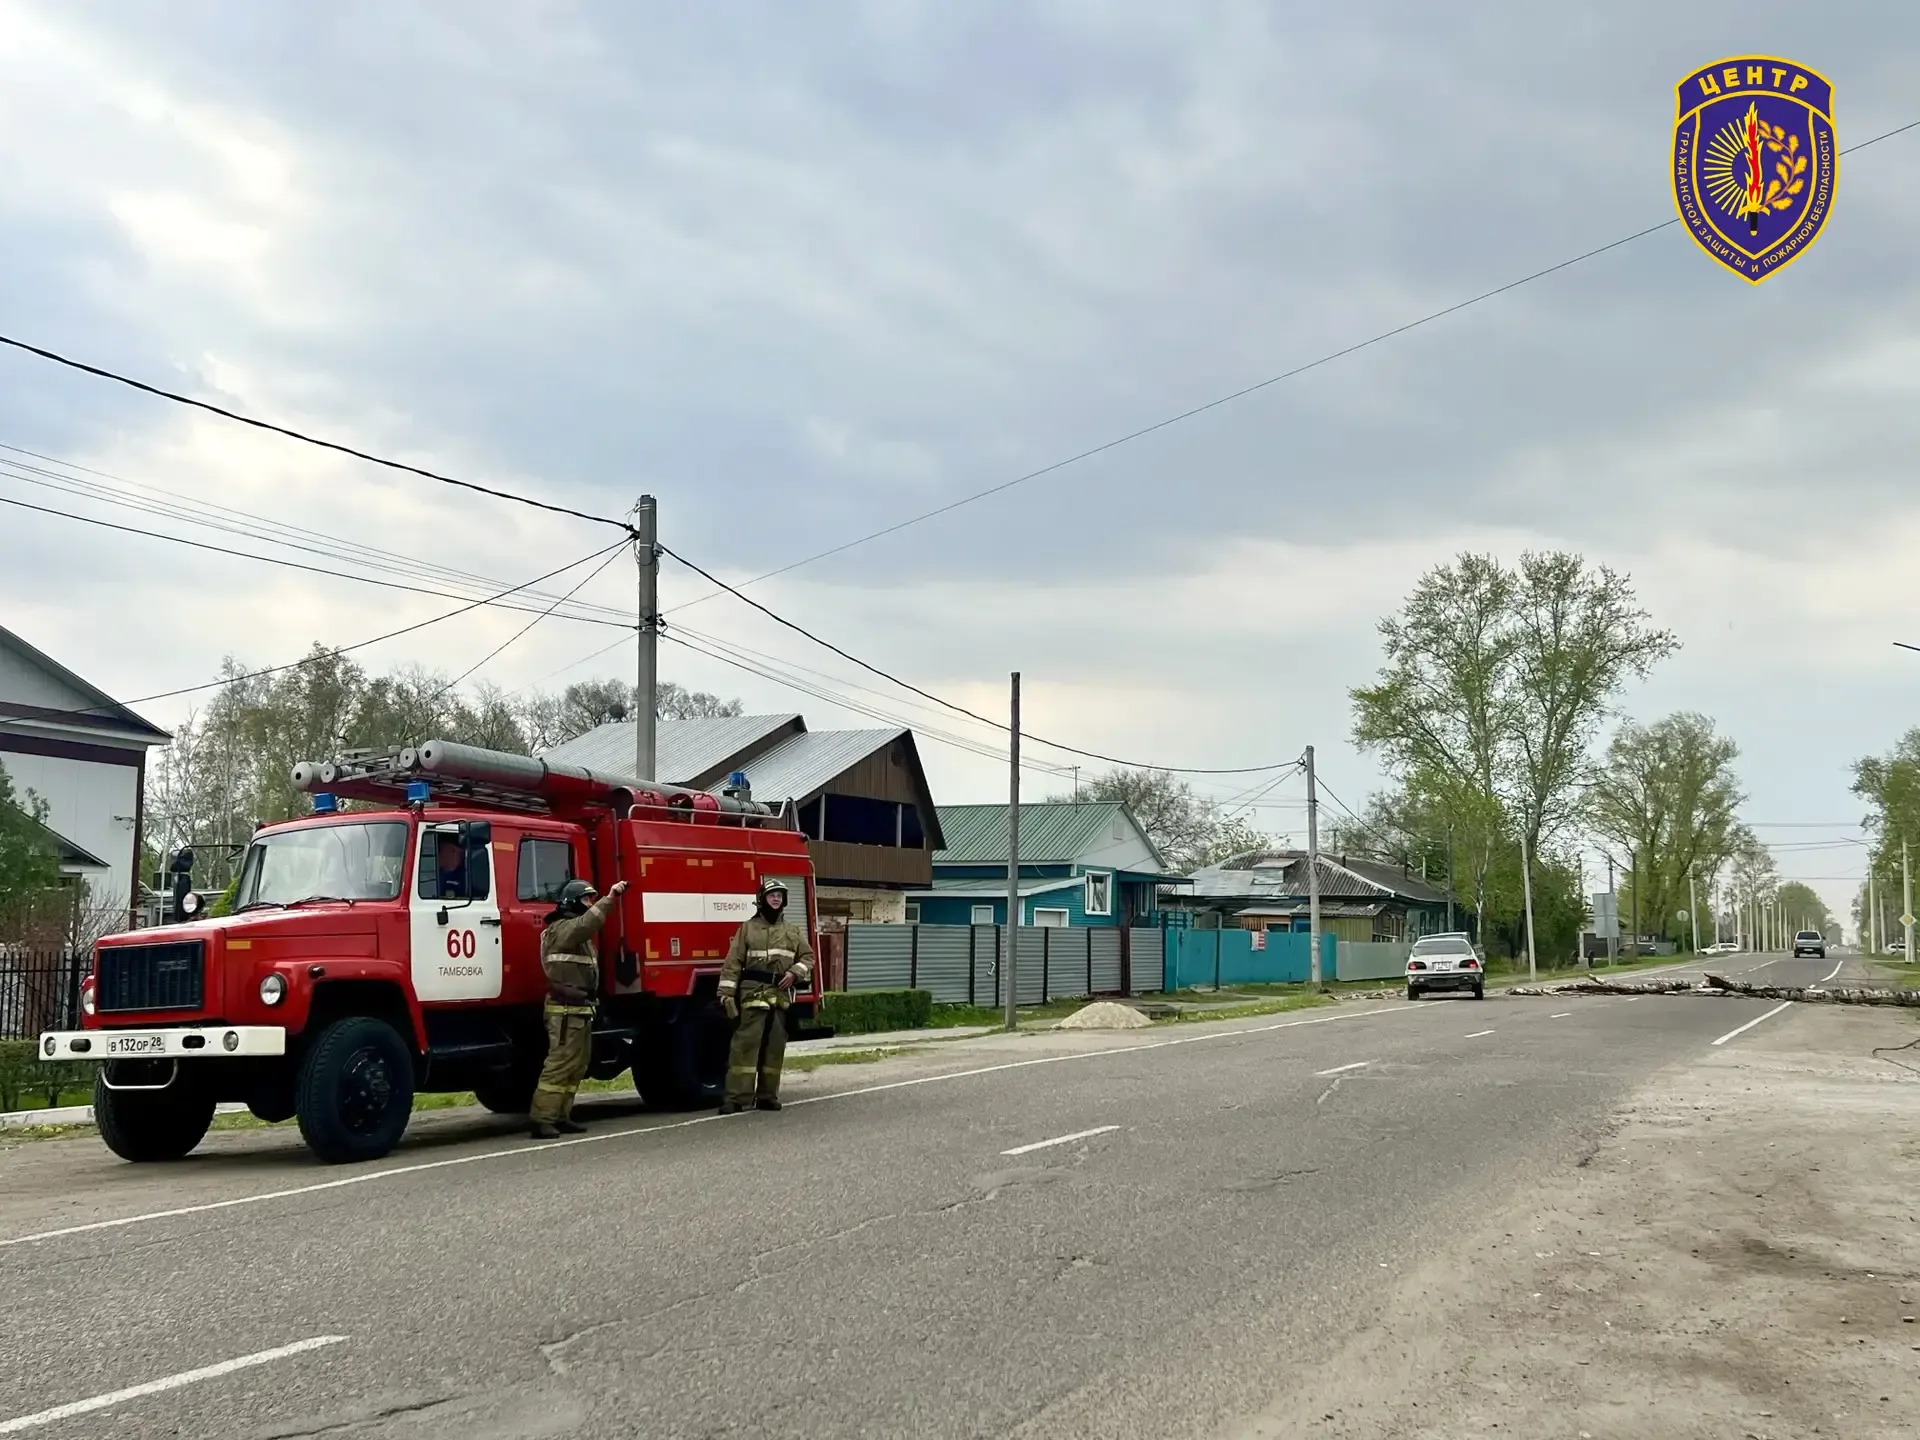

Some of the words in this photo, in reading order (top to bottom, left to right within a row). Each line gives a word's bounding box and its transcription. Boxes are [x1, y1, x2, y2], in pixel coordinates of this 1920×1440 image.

[713, 902, 740, 911] ТЕЛЕФОН
[447, 929, 476, 958] 60
[438, 966, 483, 976] ТАМБОВКА
